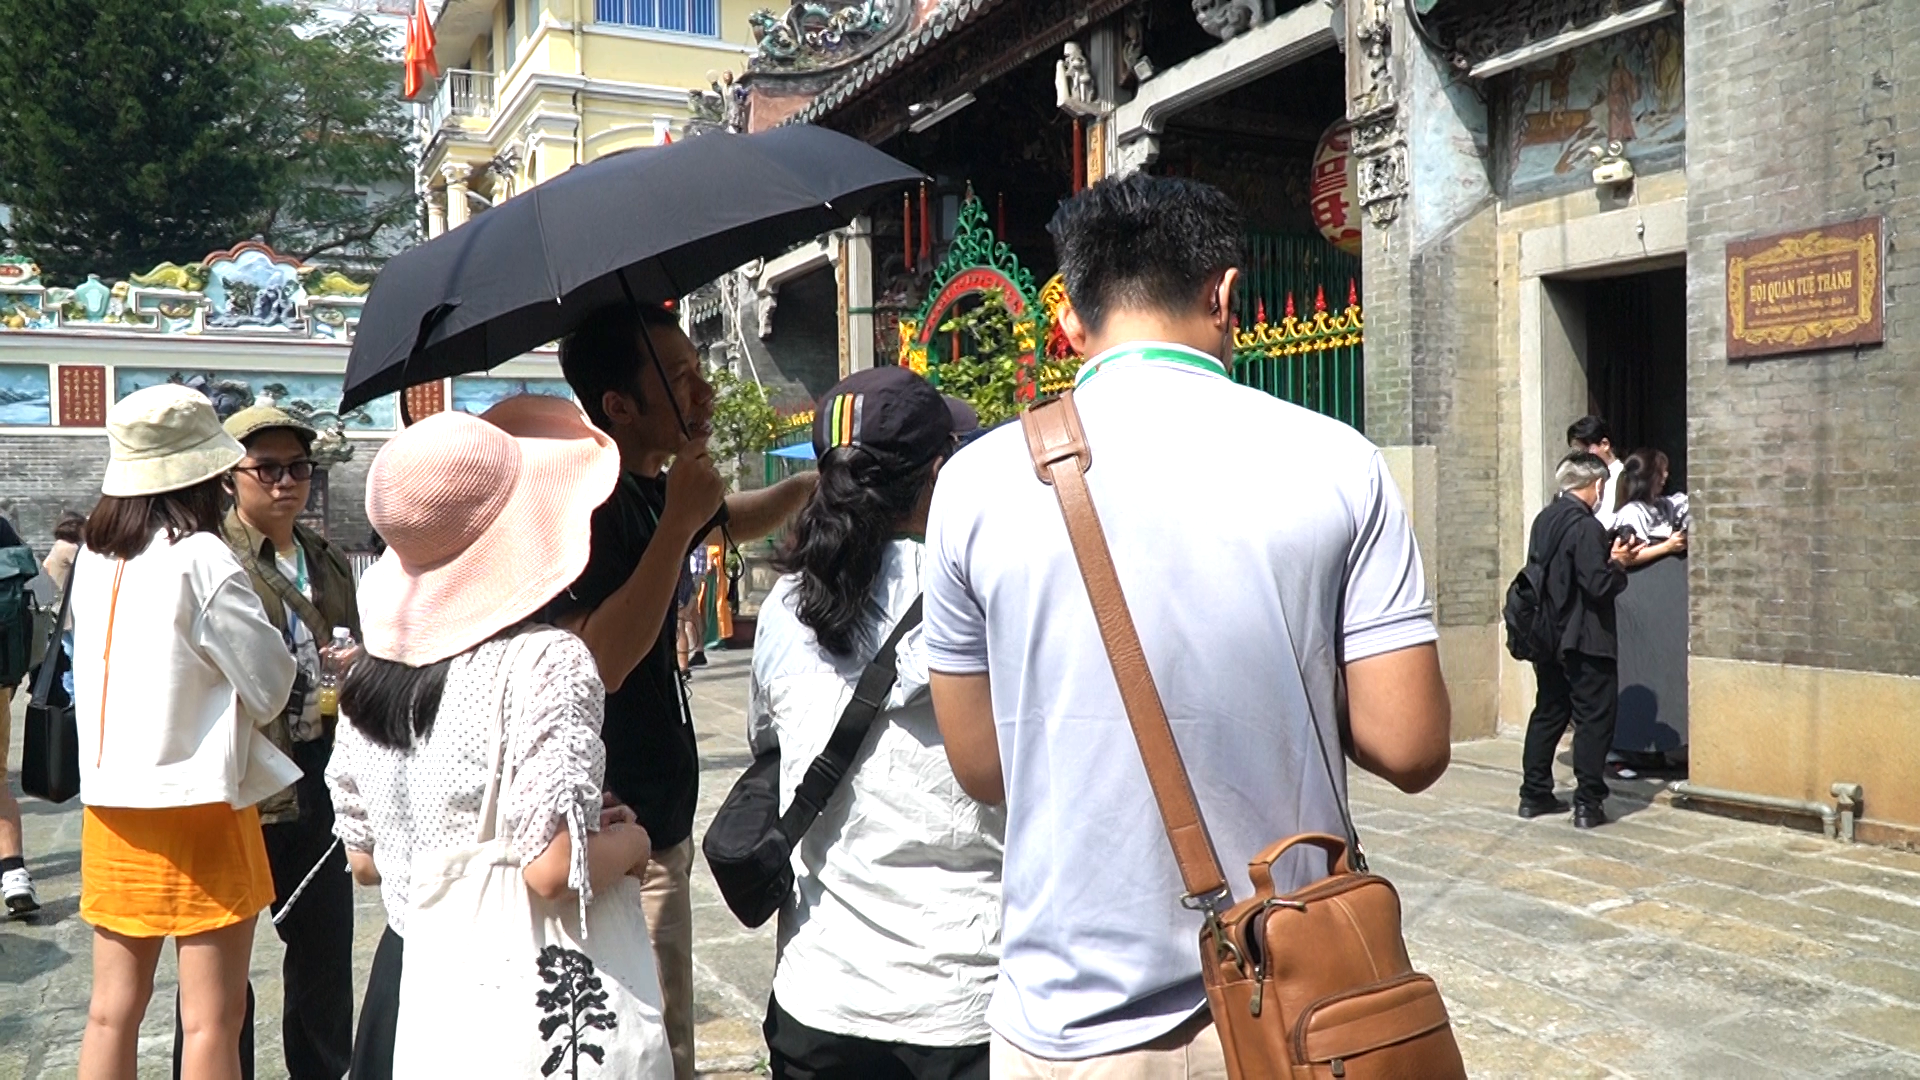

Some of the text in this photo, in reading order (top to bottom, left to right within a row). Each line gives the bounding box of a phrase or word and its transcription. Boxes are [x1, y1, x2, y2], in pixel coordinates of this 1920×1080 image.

[1749, 279, 1766, 306] HỘI
[1767, 275, 1795, 304] QUÁN
[1796, 270, 1816, 298] TUỆ
